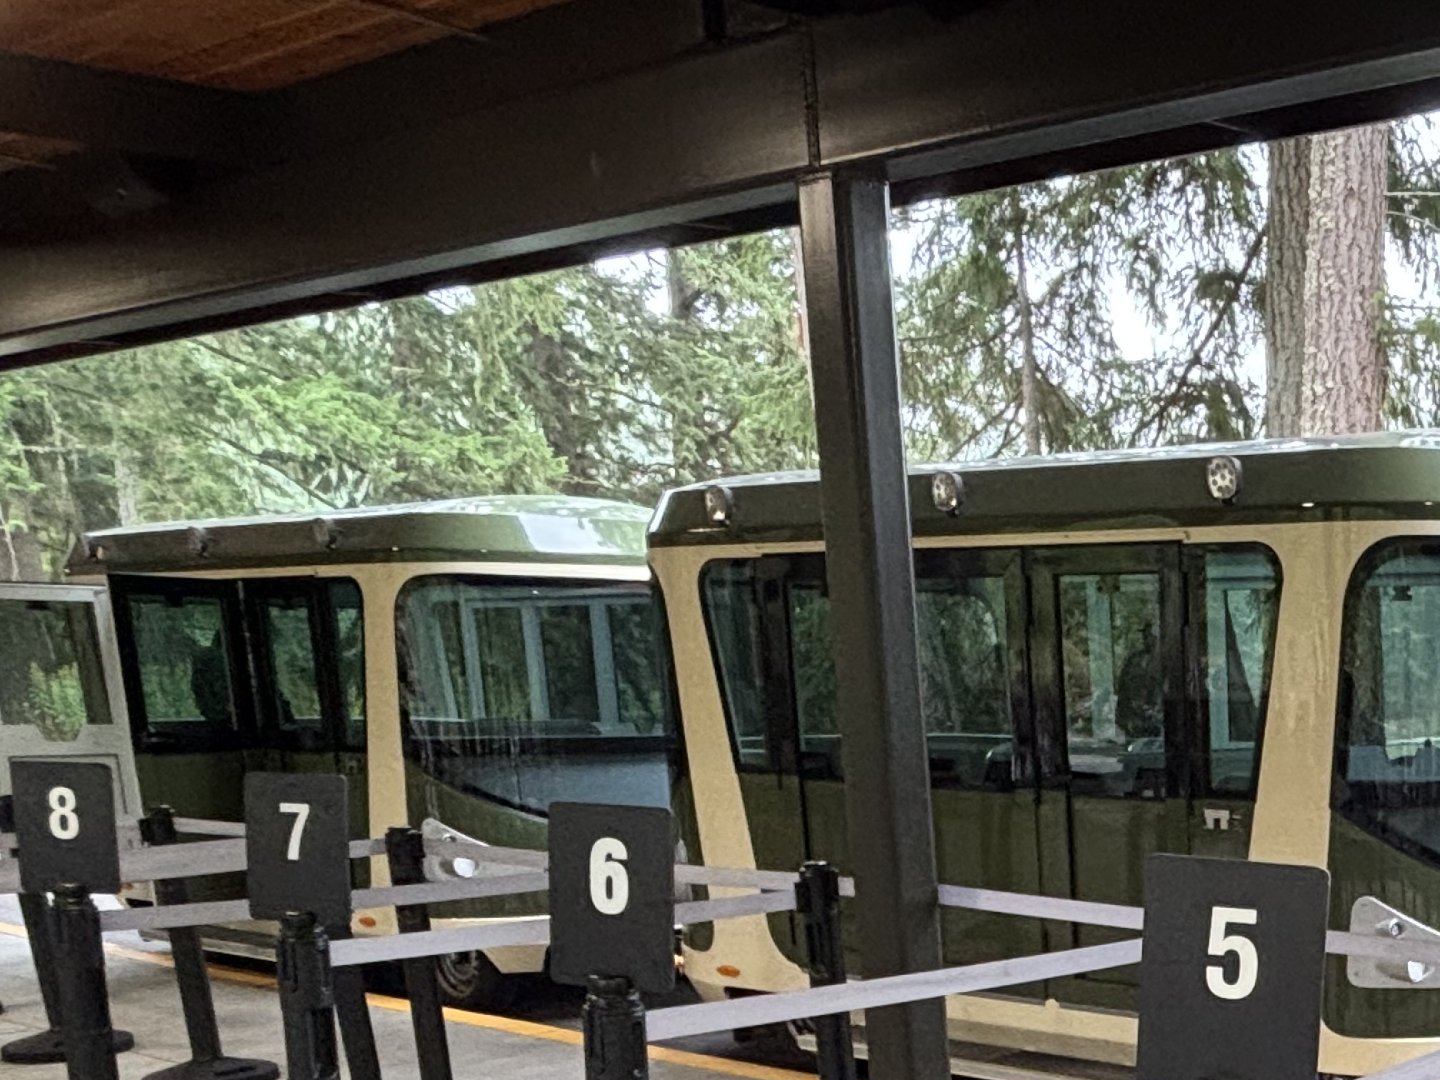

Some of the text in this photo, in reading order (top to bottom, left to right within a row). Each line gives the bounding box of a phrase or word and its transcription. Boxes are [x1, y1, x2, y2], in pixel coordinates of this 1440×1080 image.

[48, 786, 80, 840] 8
[279, 802, 310, 861] 7
[589, 837, 629, 915] 6
[1205, 906, 1259, 1000] 5
